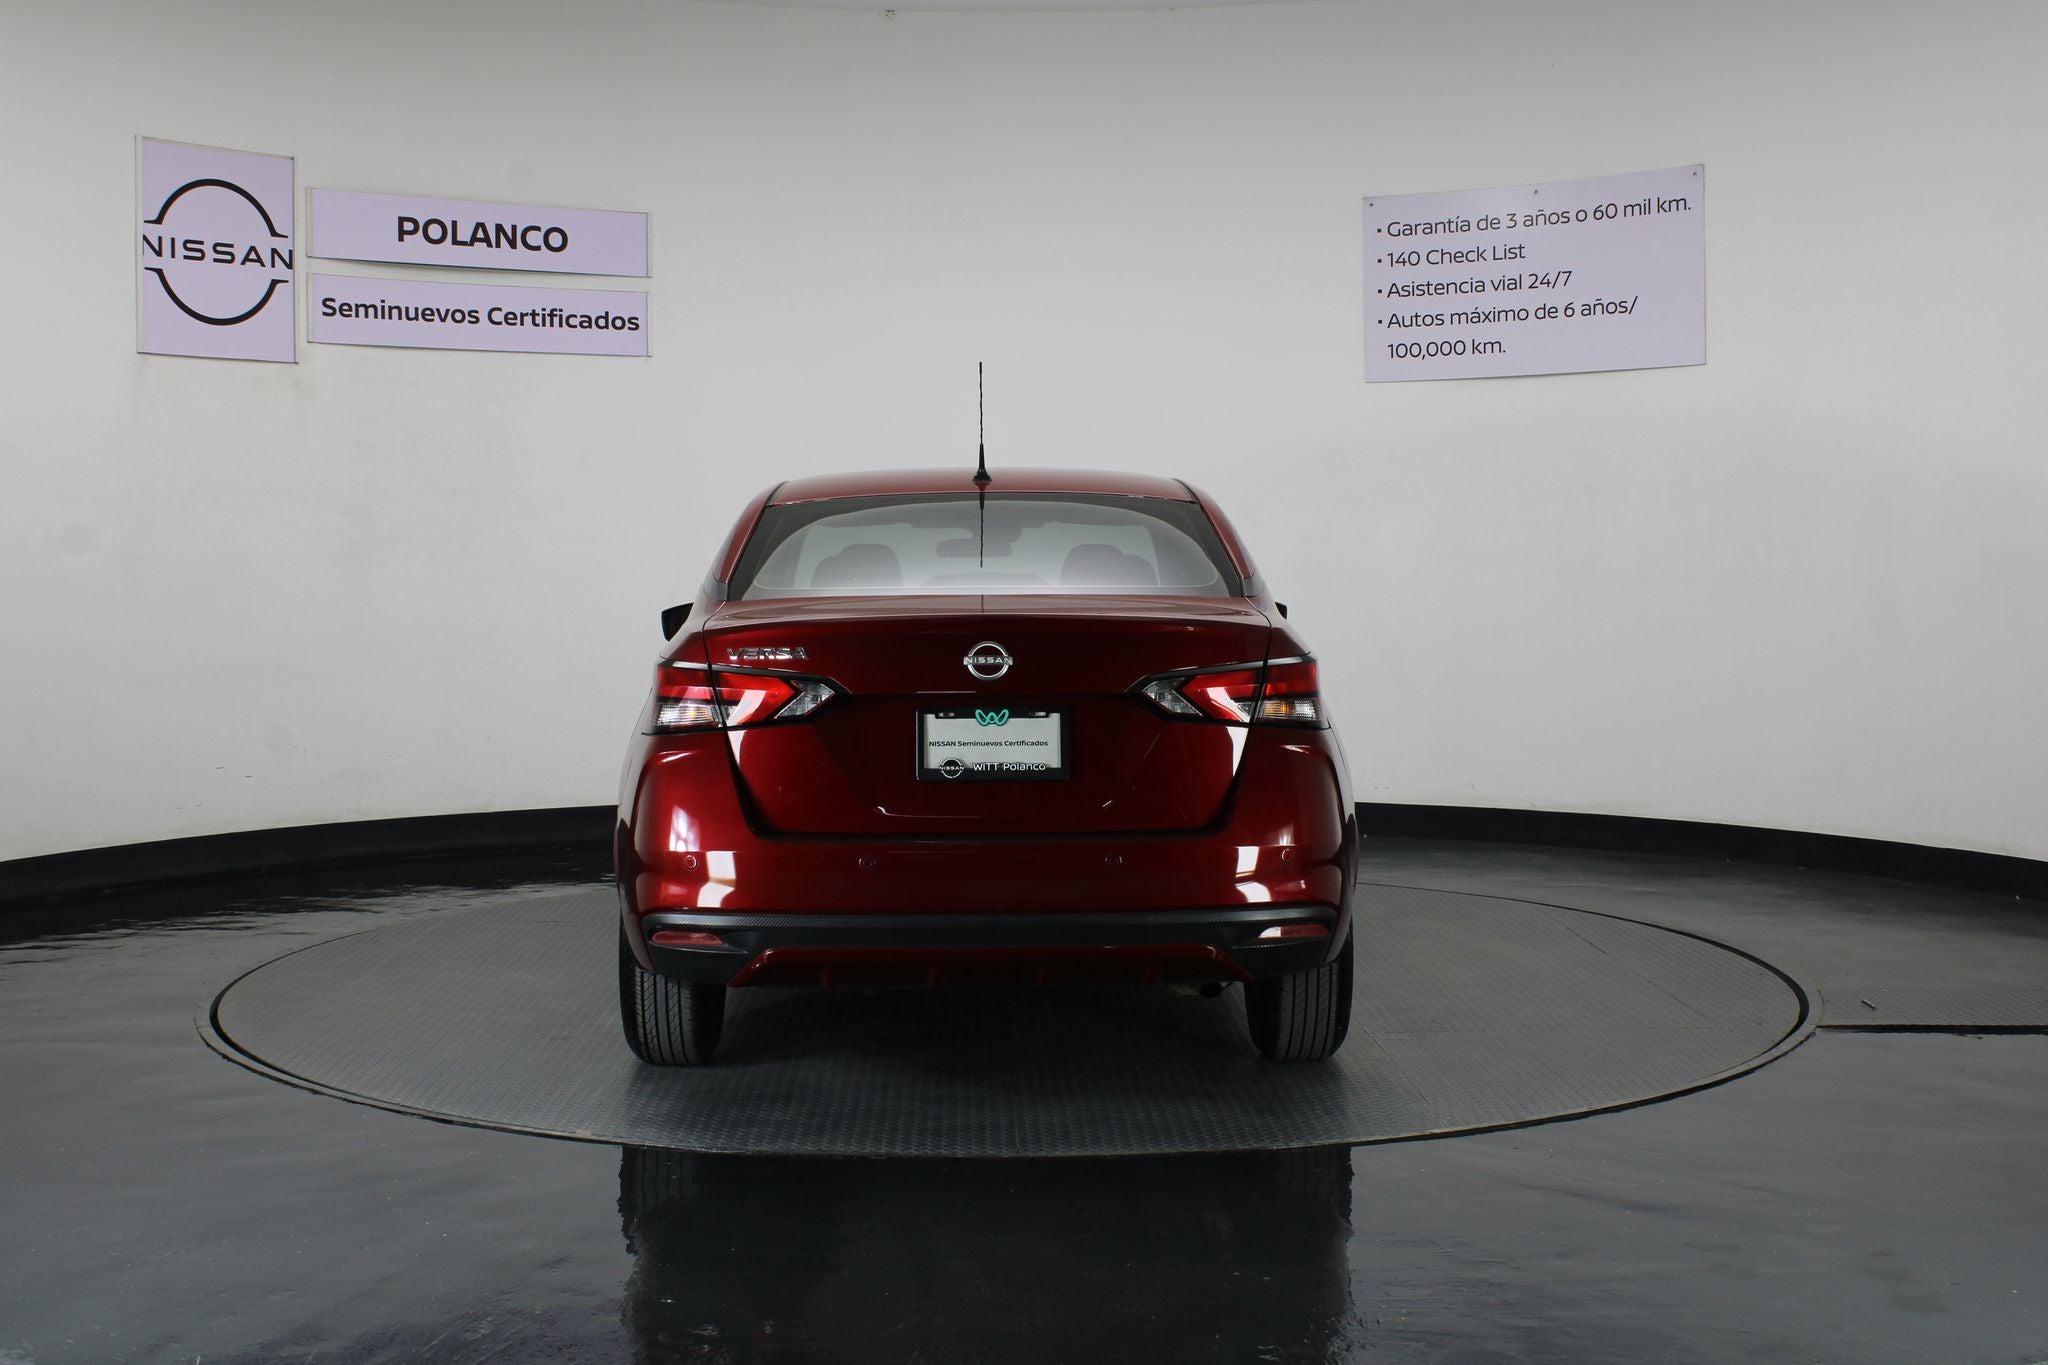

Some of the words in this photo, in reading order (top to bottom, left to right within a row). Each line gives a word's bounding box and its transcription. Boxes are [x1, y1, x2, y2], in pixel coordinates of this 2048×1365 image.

[1387, 215, 1471, 237] Garantía
[1477, 213, 1501, 231] de
[1506, 213, 1518, 229] 3
[1523, 209, 1570, 227] años
[1575, 210, 1588, 223] o
[1593, 203, 1618, 219] 60
[1623, 199, 1651, 217] mil
[1657, 197, 1692, 213] km.
[397, 216, 569, 253] POLANCO
[142, 234, 293, 270] NISSAN
[1387, 251, 1420, 267] 140
[1426, 246, 1487, 265] Check
[1493, 243, 1526, 261] List
[1387, 277, 1486, 298] Asistencia
[1491, 274, 1522, 291] vial
[1528, 270, 1573, 289] 24/7
[321, 297, 480, 325] Seminuevos
[487, 306, 640, 332] Certificados
[1387, 313, 1445, 329] Autos
[1450, 306, 1529, 326] máximo
[1534, 304, 1558, 320] de
[1564, 302, 1575, 317] 6
[1580, 296, 1638, 316] años/
[1387, 340, 1466, 360] 100,000
[1471, 338, 1506, 355] km.
[727, 647, 809, 661] VERSA
[965, 656, 1012, 666] NISSAN
[1003, 762, 1046, 771] Polanco
